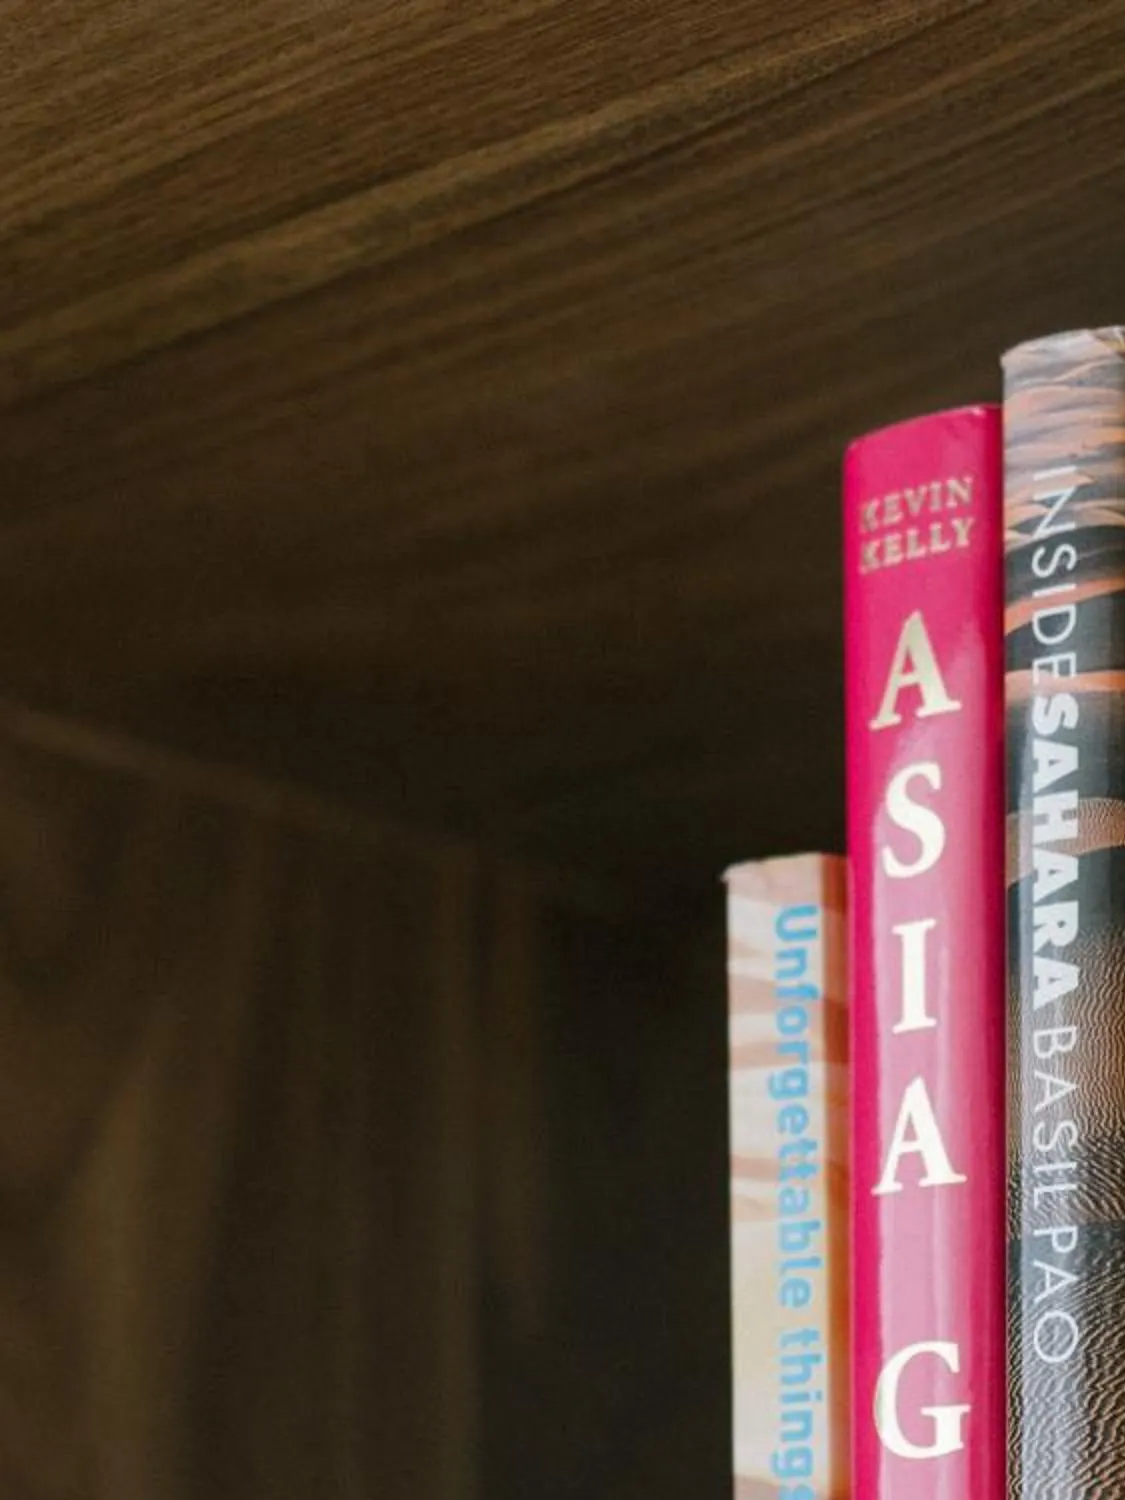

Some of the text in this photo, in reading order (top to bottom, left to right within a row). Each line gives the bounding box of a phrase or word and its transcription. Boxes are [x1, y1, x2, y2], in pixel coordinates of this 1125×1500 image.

[859, 477, 974, 534] KEVIN
[859, 517, 975, 575] KELLY
[869, 610, 967, 1194] ASIA
[768, 905, 826, 1309] Unforgettable
[1032, 1027, 1078, 1210] BASIL
[1032, 1227, 1080, 1365] PAO
